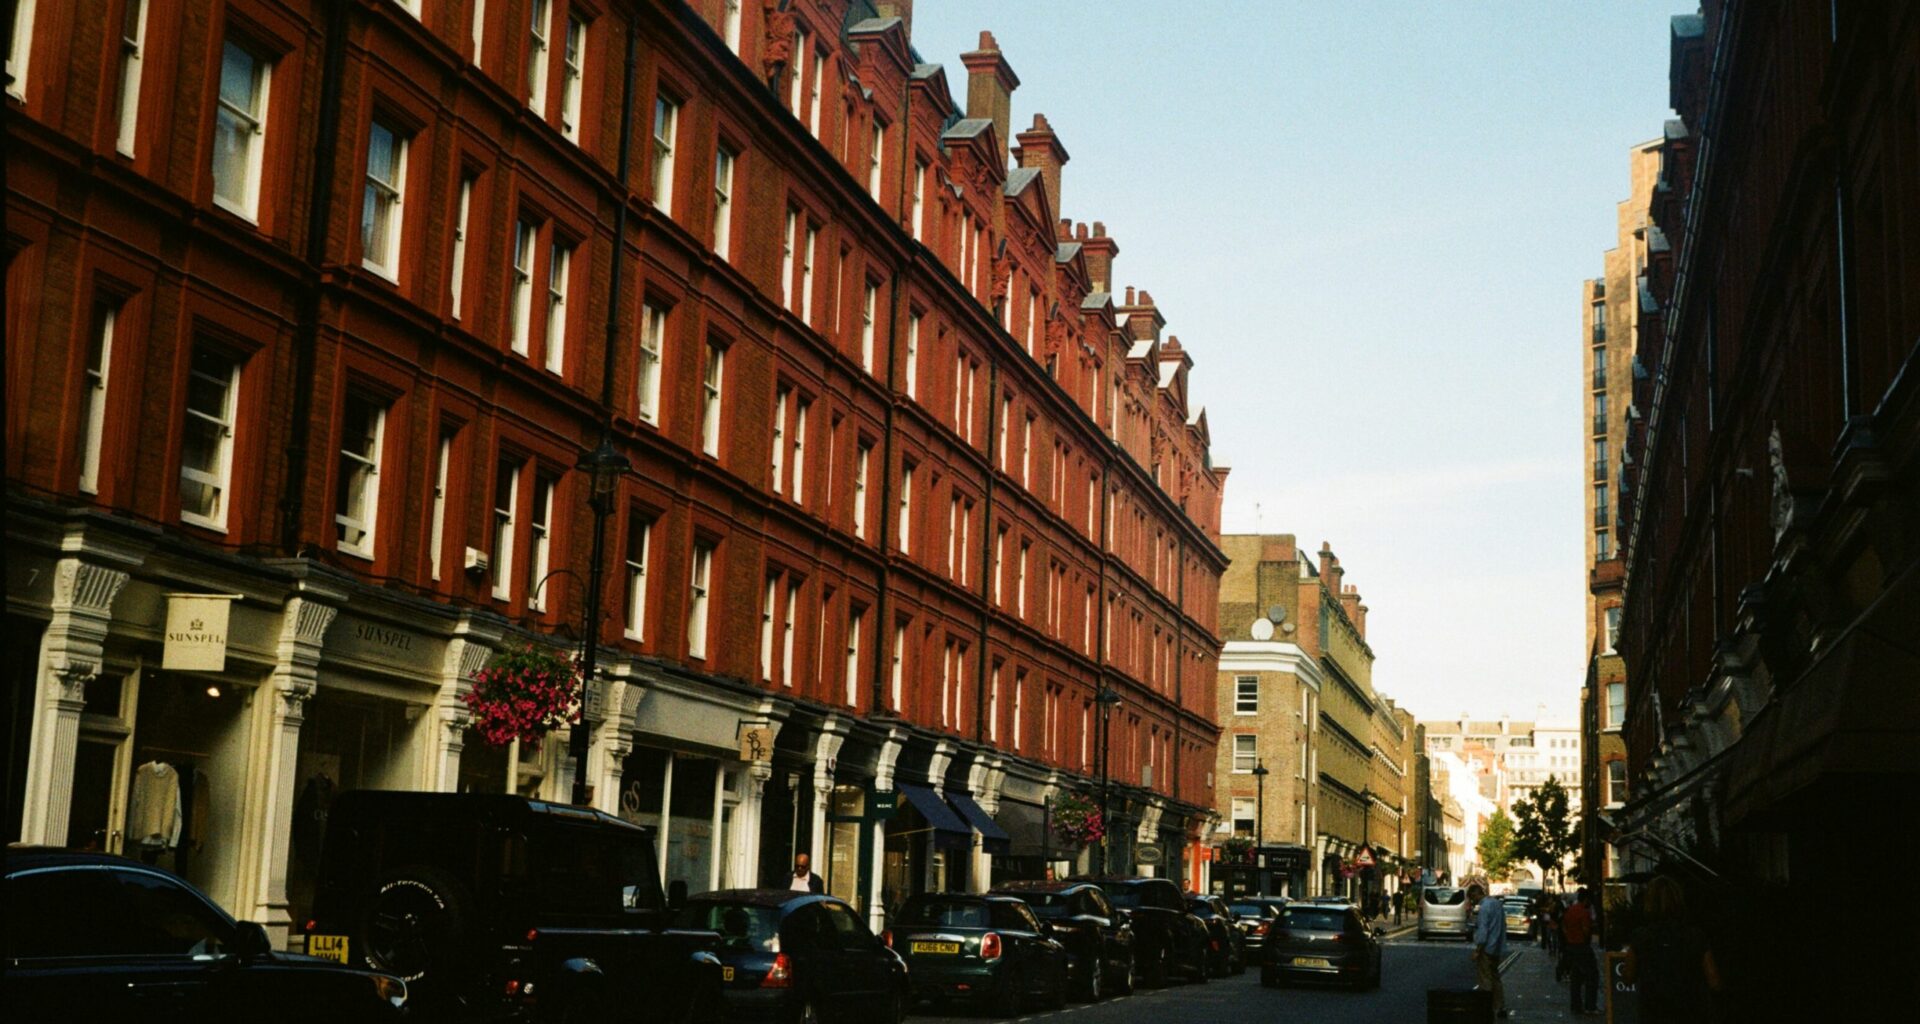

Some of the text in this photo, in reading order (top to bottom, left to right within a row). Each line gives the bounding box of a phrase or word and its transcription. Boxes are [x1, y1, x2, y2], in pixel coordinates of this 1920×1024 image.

[28, 568, 40, 587] 7
[169, 632, 225, 645] SUNSPEL
[355, 624, 411, 650] SUNSPEL
[314, 935, 344, 951] LL14
